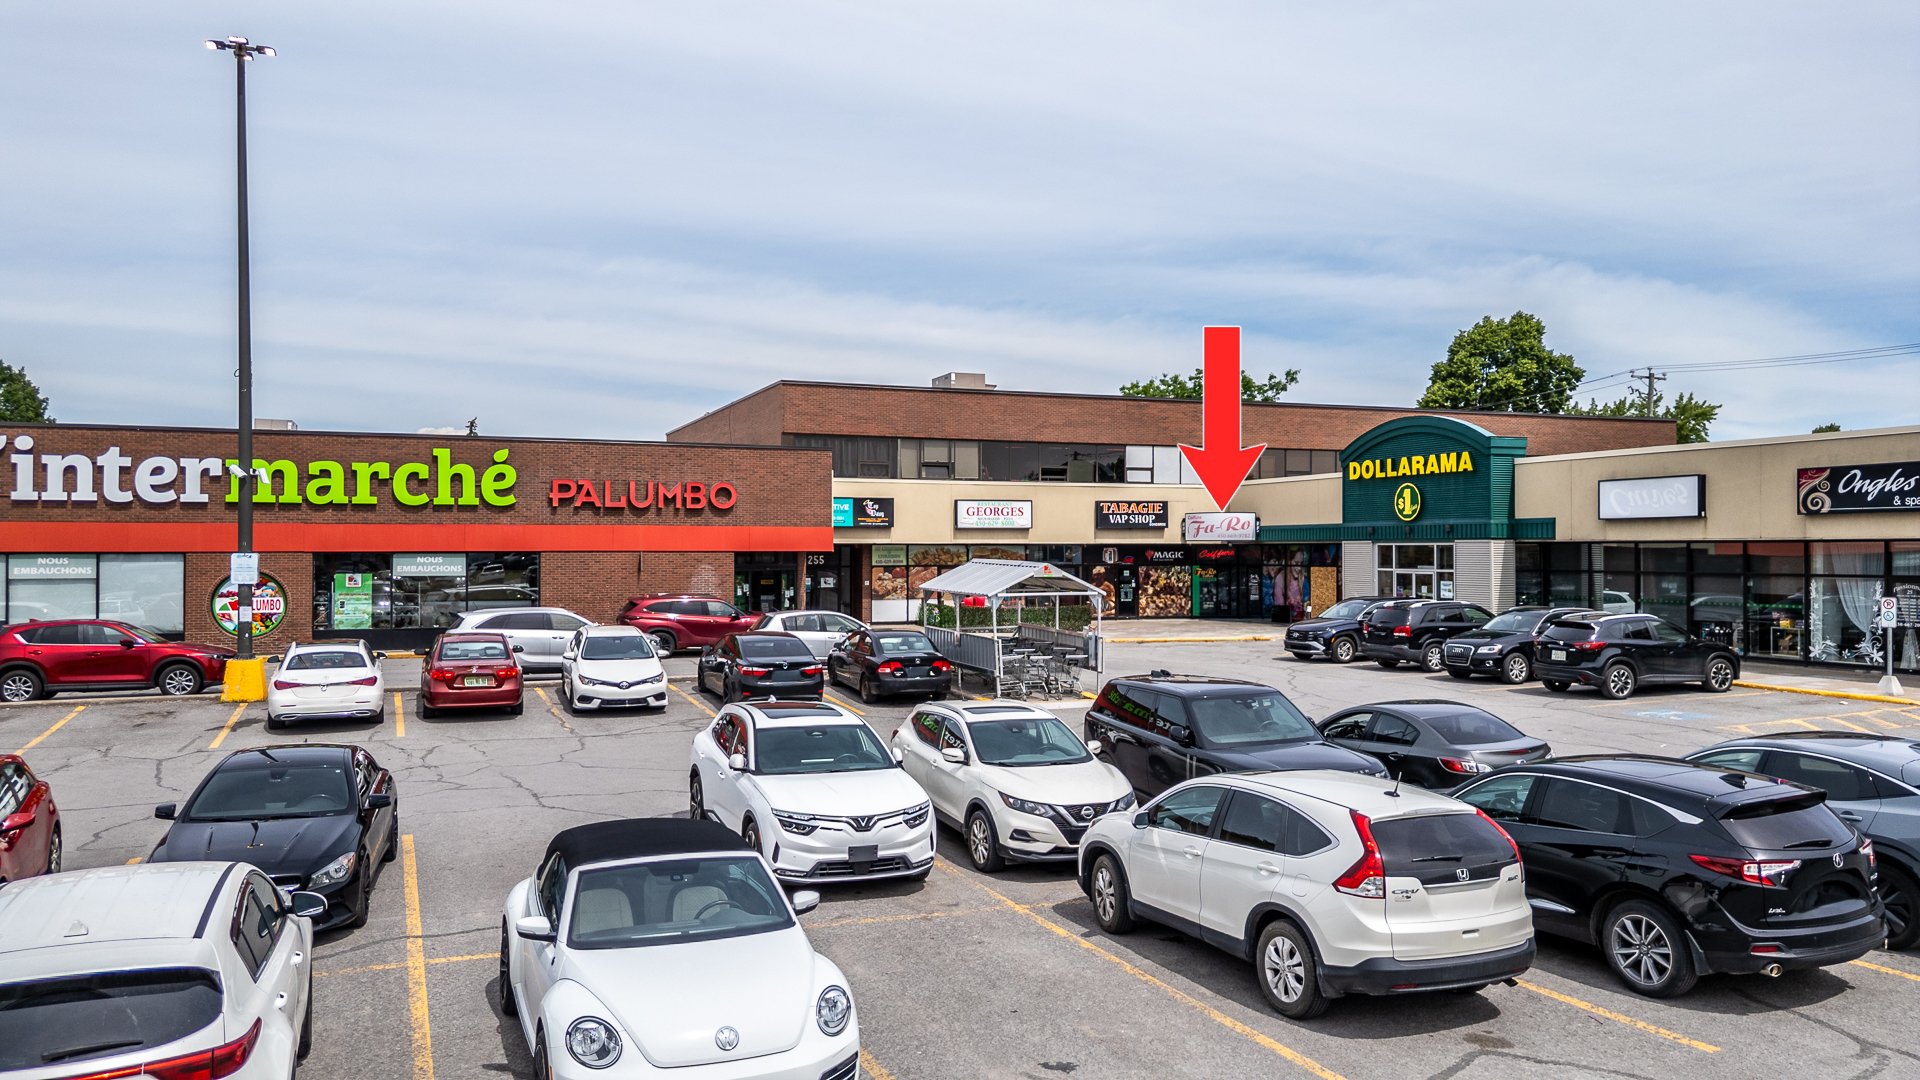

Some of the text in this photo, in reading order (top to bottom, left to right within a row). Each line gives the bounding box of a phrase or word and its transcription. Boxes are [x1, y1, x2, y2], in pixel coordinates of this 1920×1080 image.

[1349, 451, 1474, 481] DOLLARAMA
[1838, 468, 1920, 501] Ongles
[548, 478, 738, 510] PALUMBO
[1893, 495, 1901, 506] &
[966, 506, 1025, 517] GEORGES
[1100, 502, 1164, 514] TABAGIE
[1109, 514, 1156, 524] VAP SHOP
[1188, 516, 1251, 539] Fa-Ro
[807, 555, 825, 565] 255
[1153, 551, 1184, 559] MAGIC
[37, 557, 70, 565] NOUS
[13, 566, 93, 575] EMBAUCHONS
[252, 599, 281, 611] LUMBO
